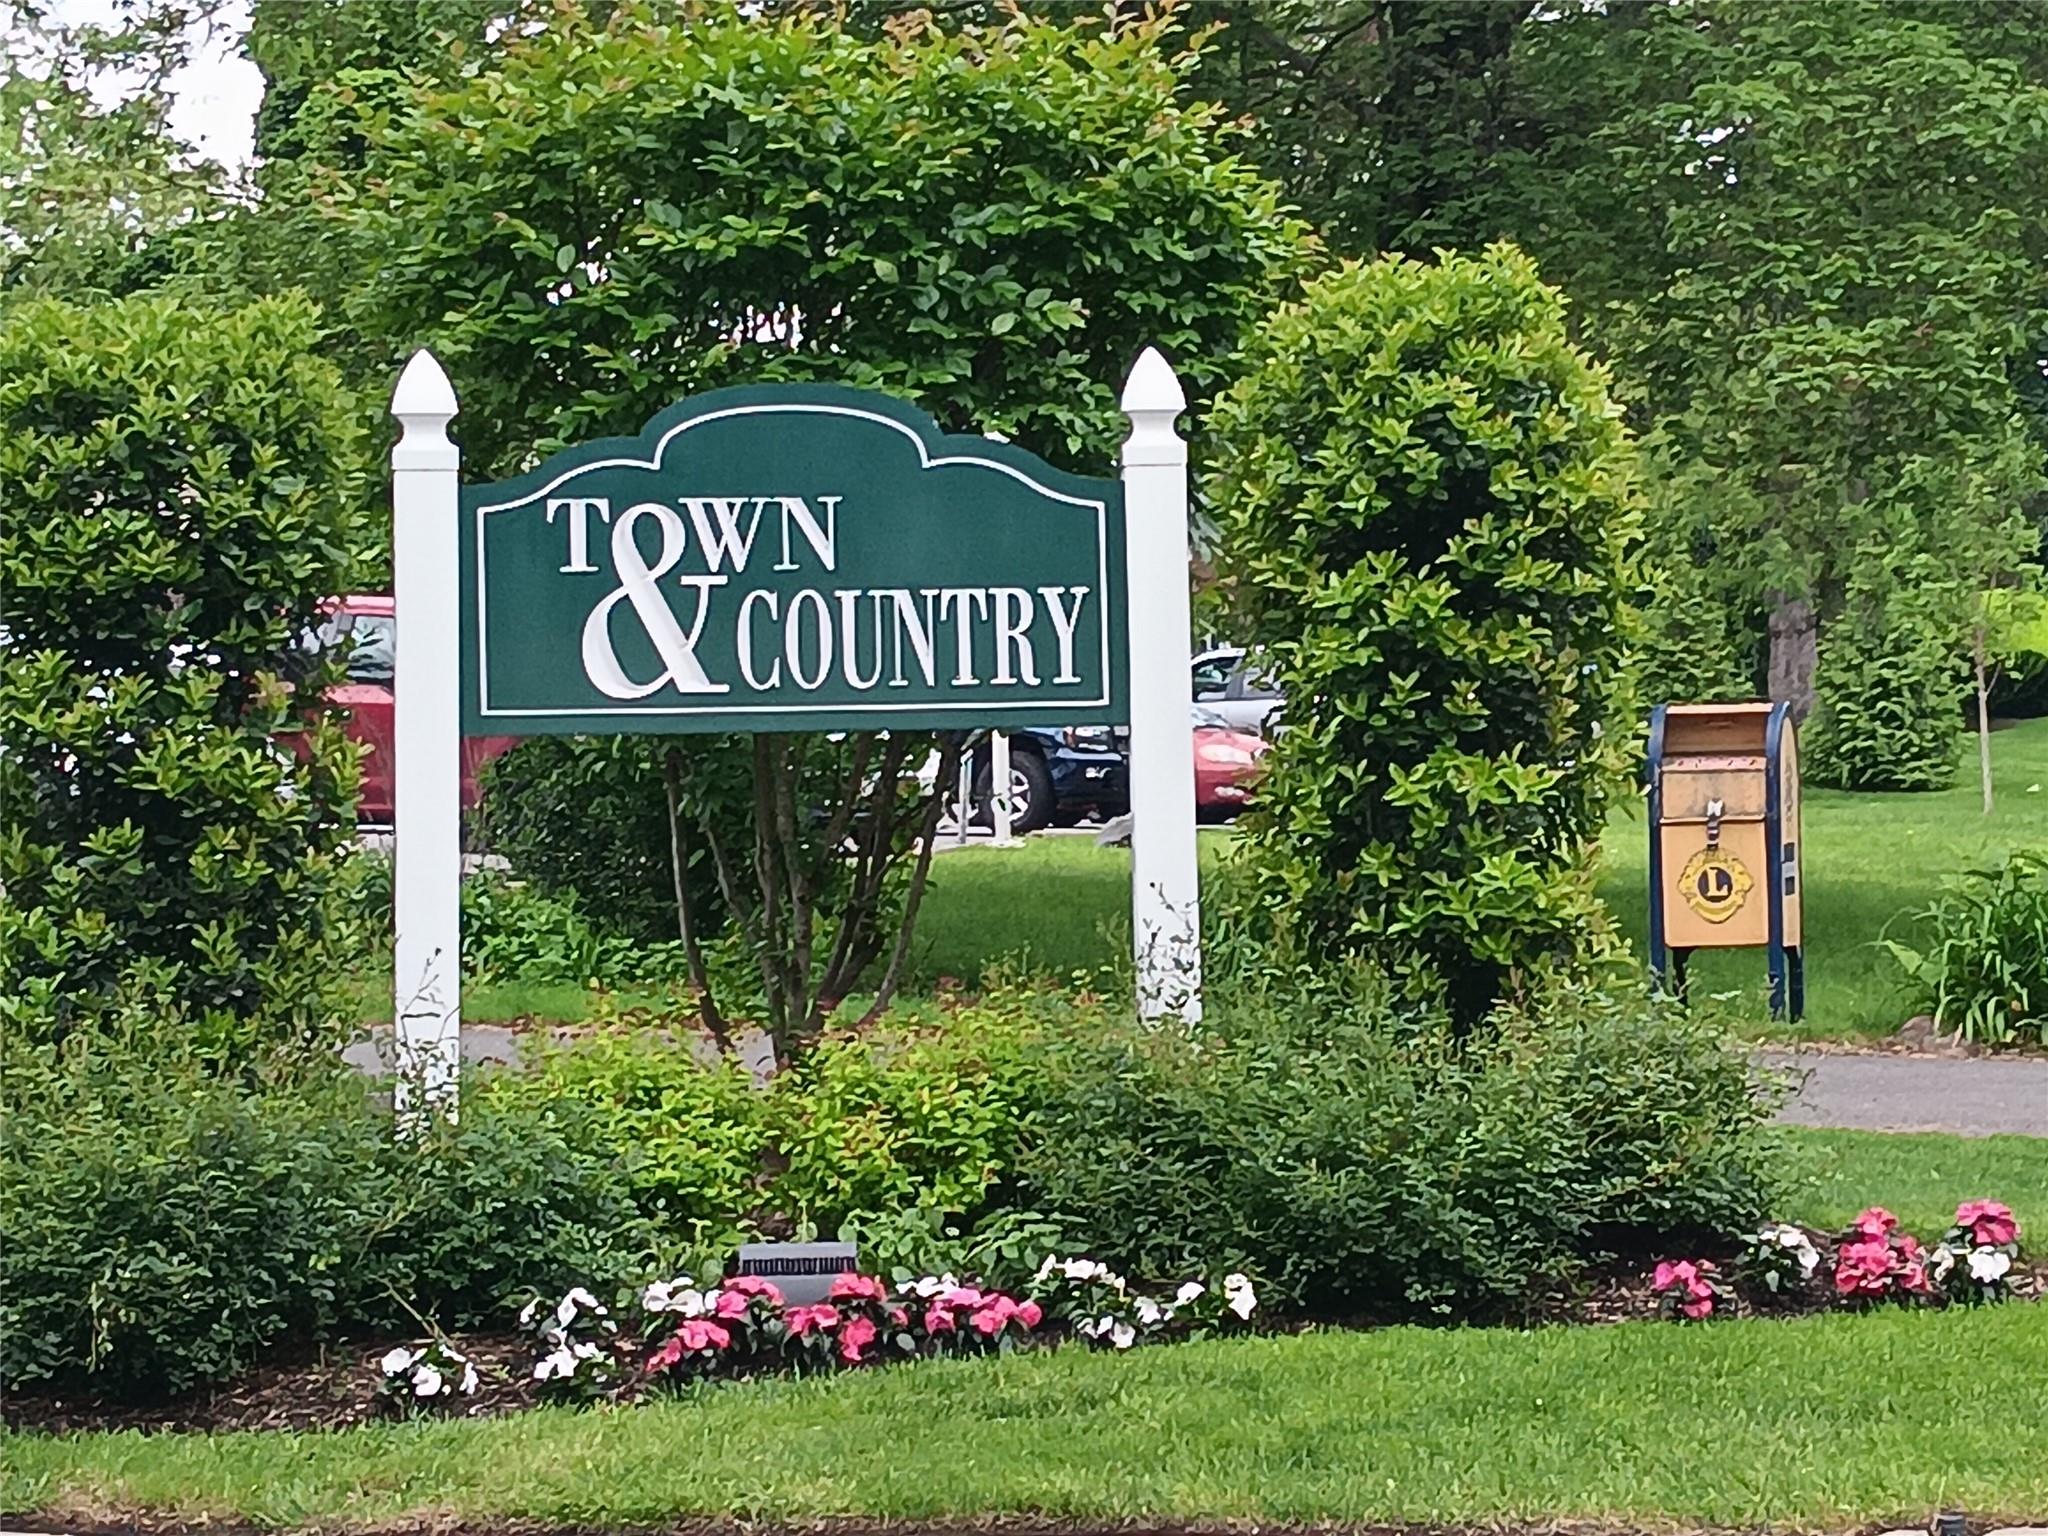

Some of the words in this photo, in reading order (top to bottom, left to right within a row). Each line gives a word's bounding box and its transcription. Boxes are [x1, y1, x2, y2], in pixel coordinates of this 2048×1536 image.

[546, 495, 843, 573] TOWN
[581, 501, 730, 700] &
[737, 585, 1090, 691] COUNTRY
[1705, 867, 1729, 897] L
